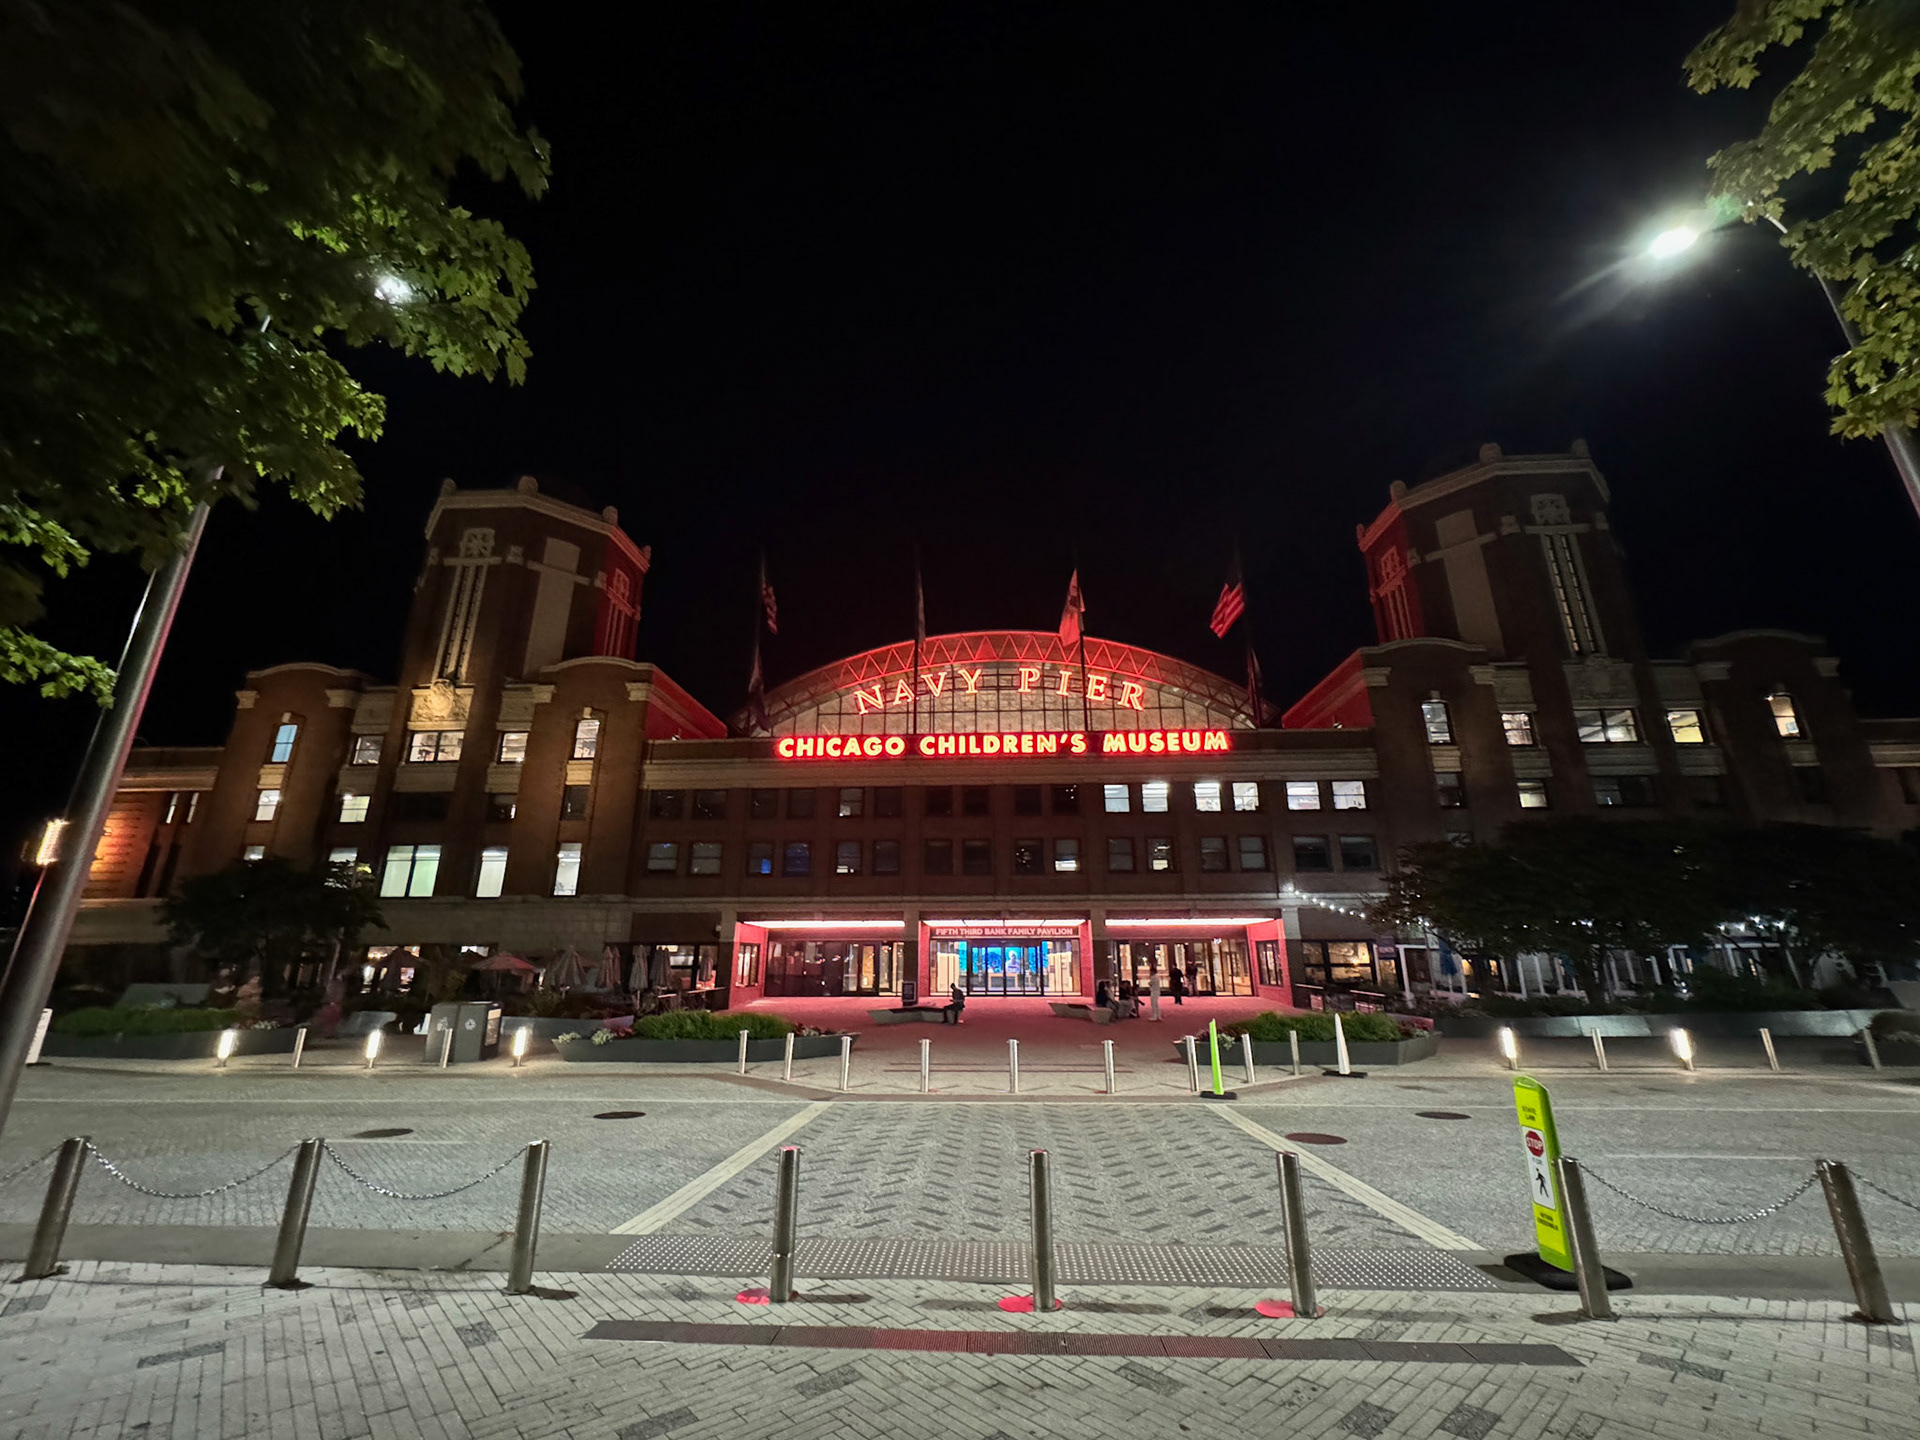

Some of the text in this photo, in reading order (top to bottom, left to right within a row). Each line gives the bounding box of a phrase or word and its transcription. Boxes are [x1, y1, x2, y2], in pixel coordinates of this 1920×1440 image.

[854, 667, 1144, 715] NAVY PIER
[779, 732, 1228, 757] CHICAGO CHILDREN'S MUSEUM
[936, 928, 1073, 936] FIFTH THIRD BANK FAMILY PAVILION
[1526, 1136, 1543, 1151] STOP
